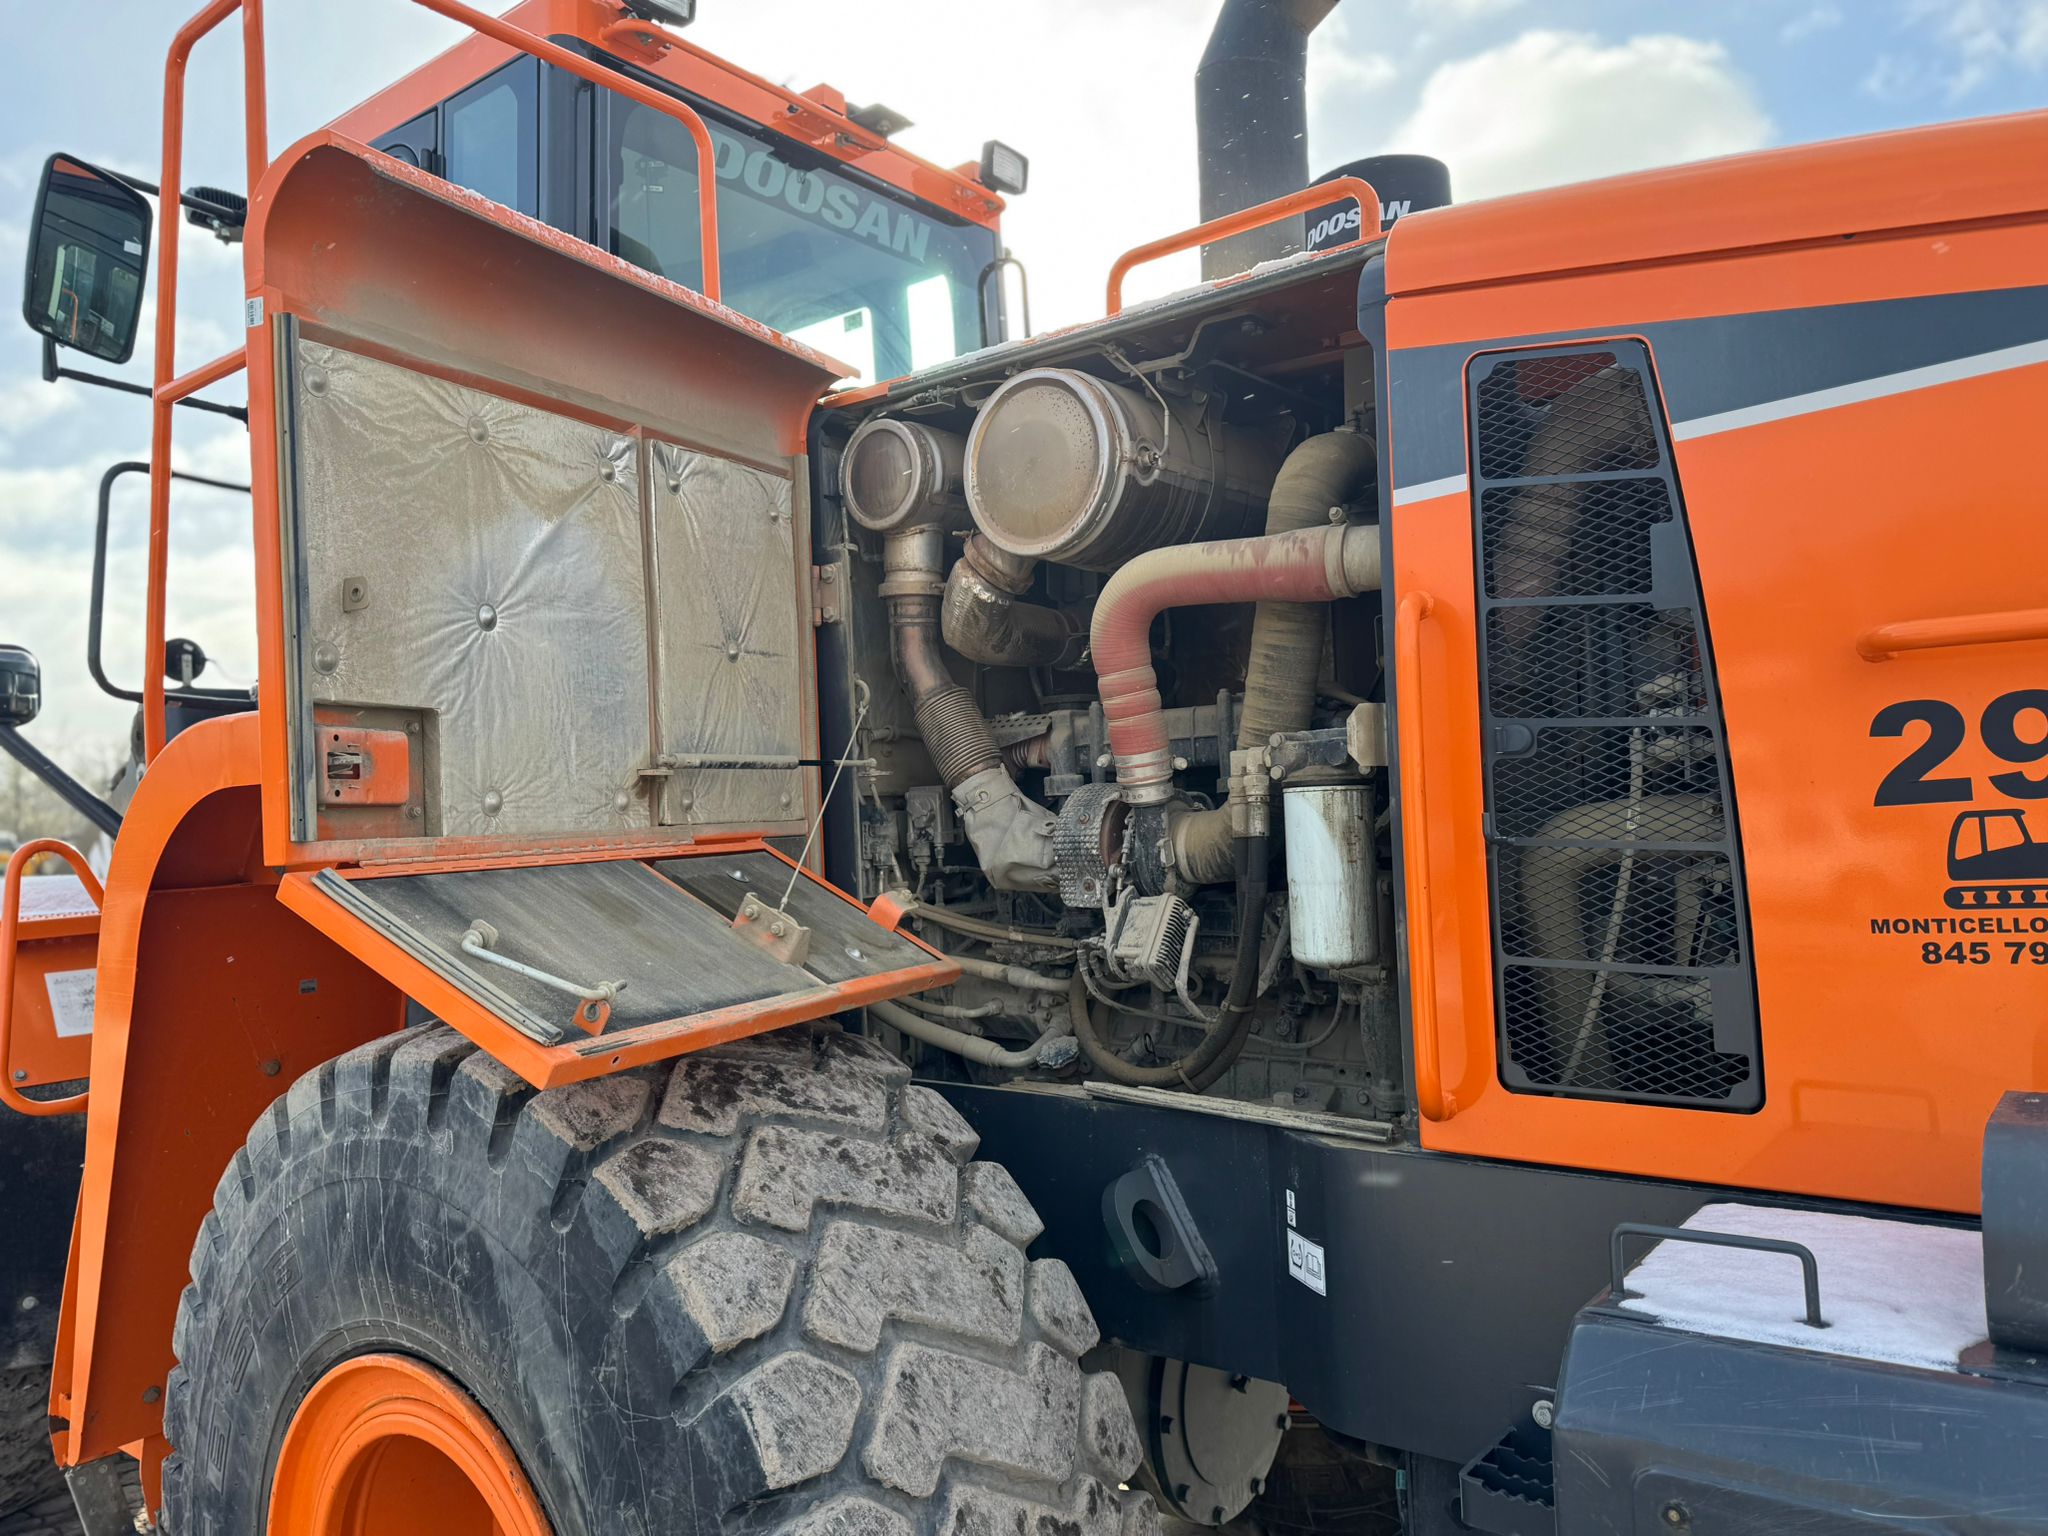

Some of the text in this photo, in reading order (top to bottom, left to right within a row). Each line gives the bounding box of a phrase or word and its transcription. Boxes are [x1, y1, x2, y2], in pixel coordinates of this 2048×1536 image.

[709, 128, 931, 263] DOOSAN
[1869, 689, 2048, 807] 29
[1870, 917, 2048, 934] MONTICELLO
[1921, 941, 2048, 965] 845 79
